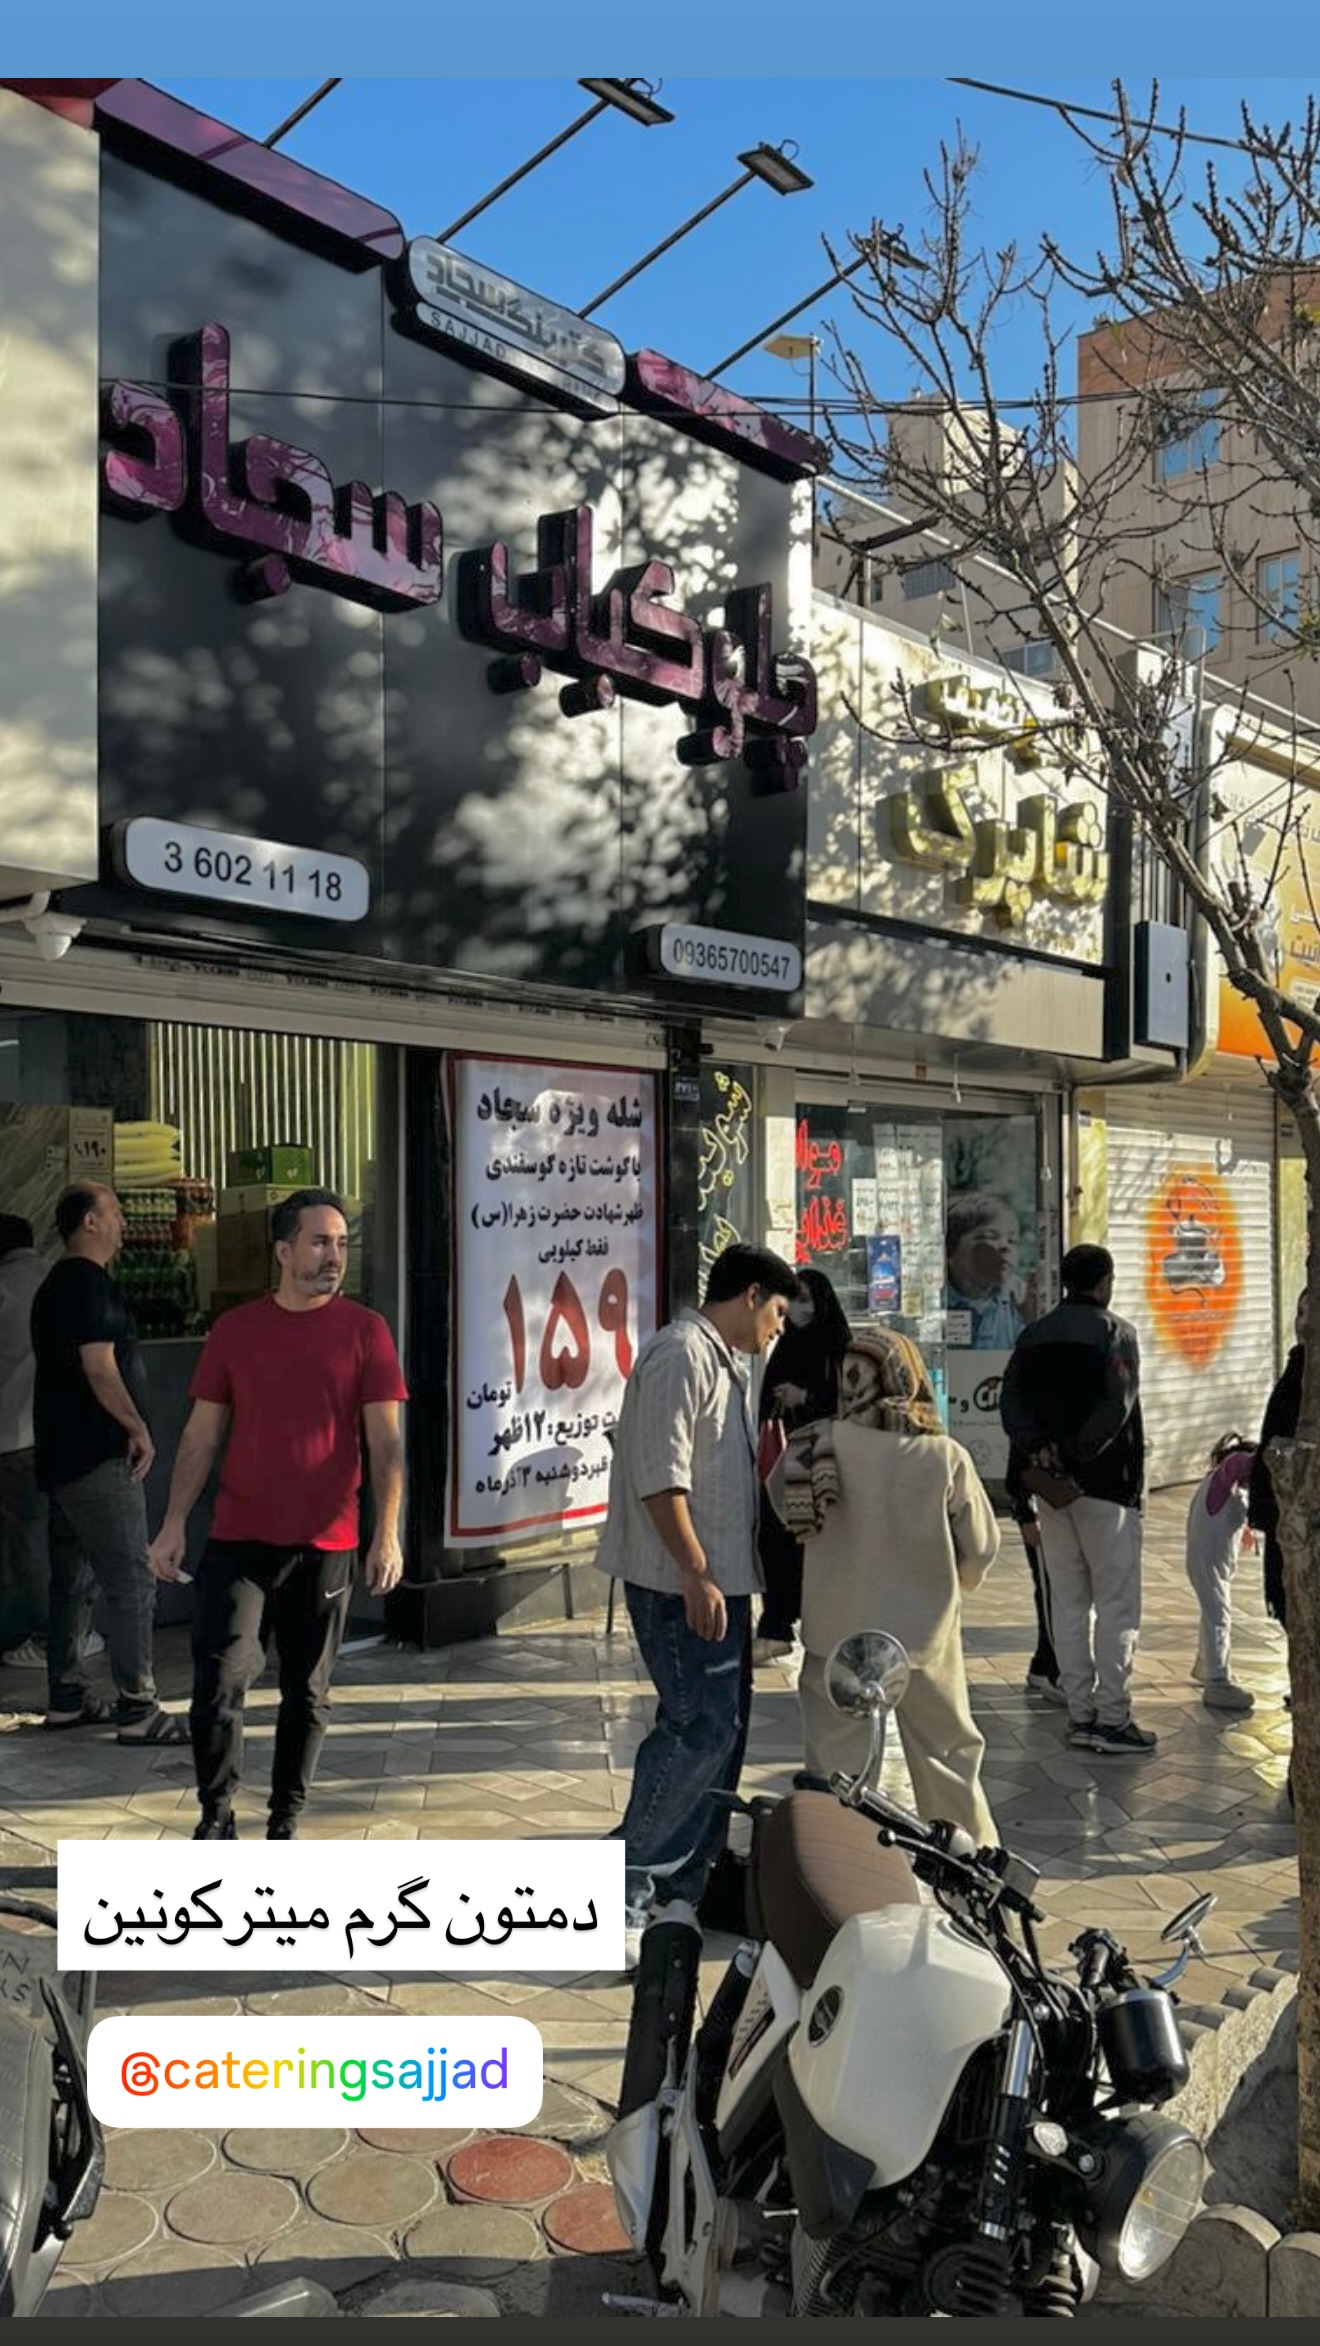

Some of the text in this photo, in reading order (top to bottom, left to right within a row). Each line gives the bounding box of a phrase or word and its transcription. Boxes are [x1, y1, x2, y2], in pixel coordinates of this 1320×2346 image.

[426, 253, 506, 315] سجاد
[430, 312, 507, 360] SAJJAD
[101, 323, 444, 604] سجاد
[164, 841, 343, 902] 3 602 11 18
[672, 937, 791, 982] 09365700547
[476, 1087, 643, 1136] شله ویژه سجاد
[486, 1152, 555, 1181] گوسفندی
[559, 1154, 586, 1182] تازه
[589, 1155, 630, 1182] گوشت
[538, 1203, 581, 1228] حضرت
[583, 1202, 622, 1225] شهادت
[623, 1202, 644, 1226] ظهر
[585, 1235, 609, 1257] فقط
[503, 1268, 634, 1395] ۱۵۹
[466, 1380, 513, 1410] تومان
